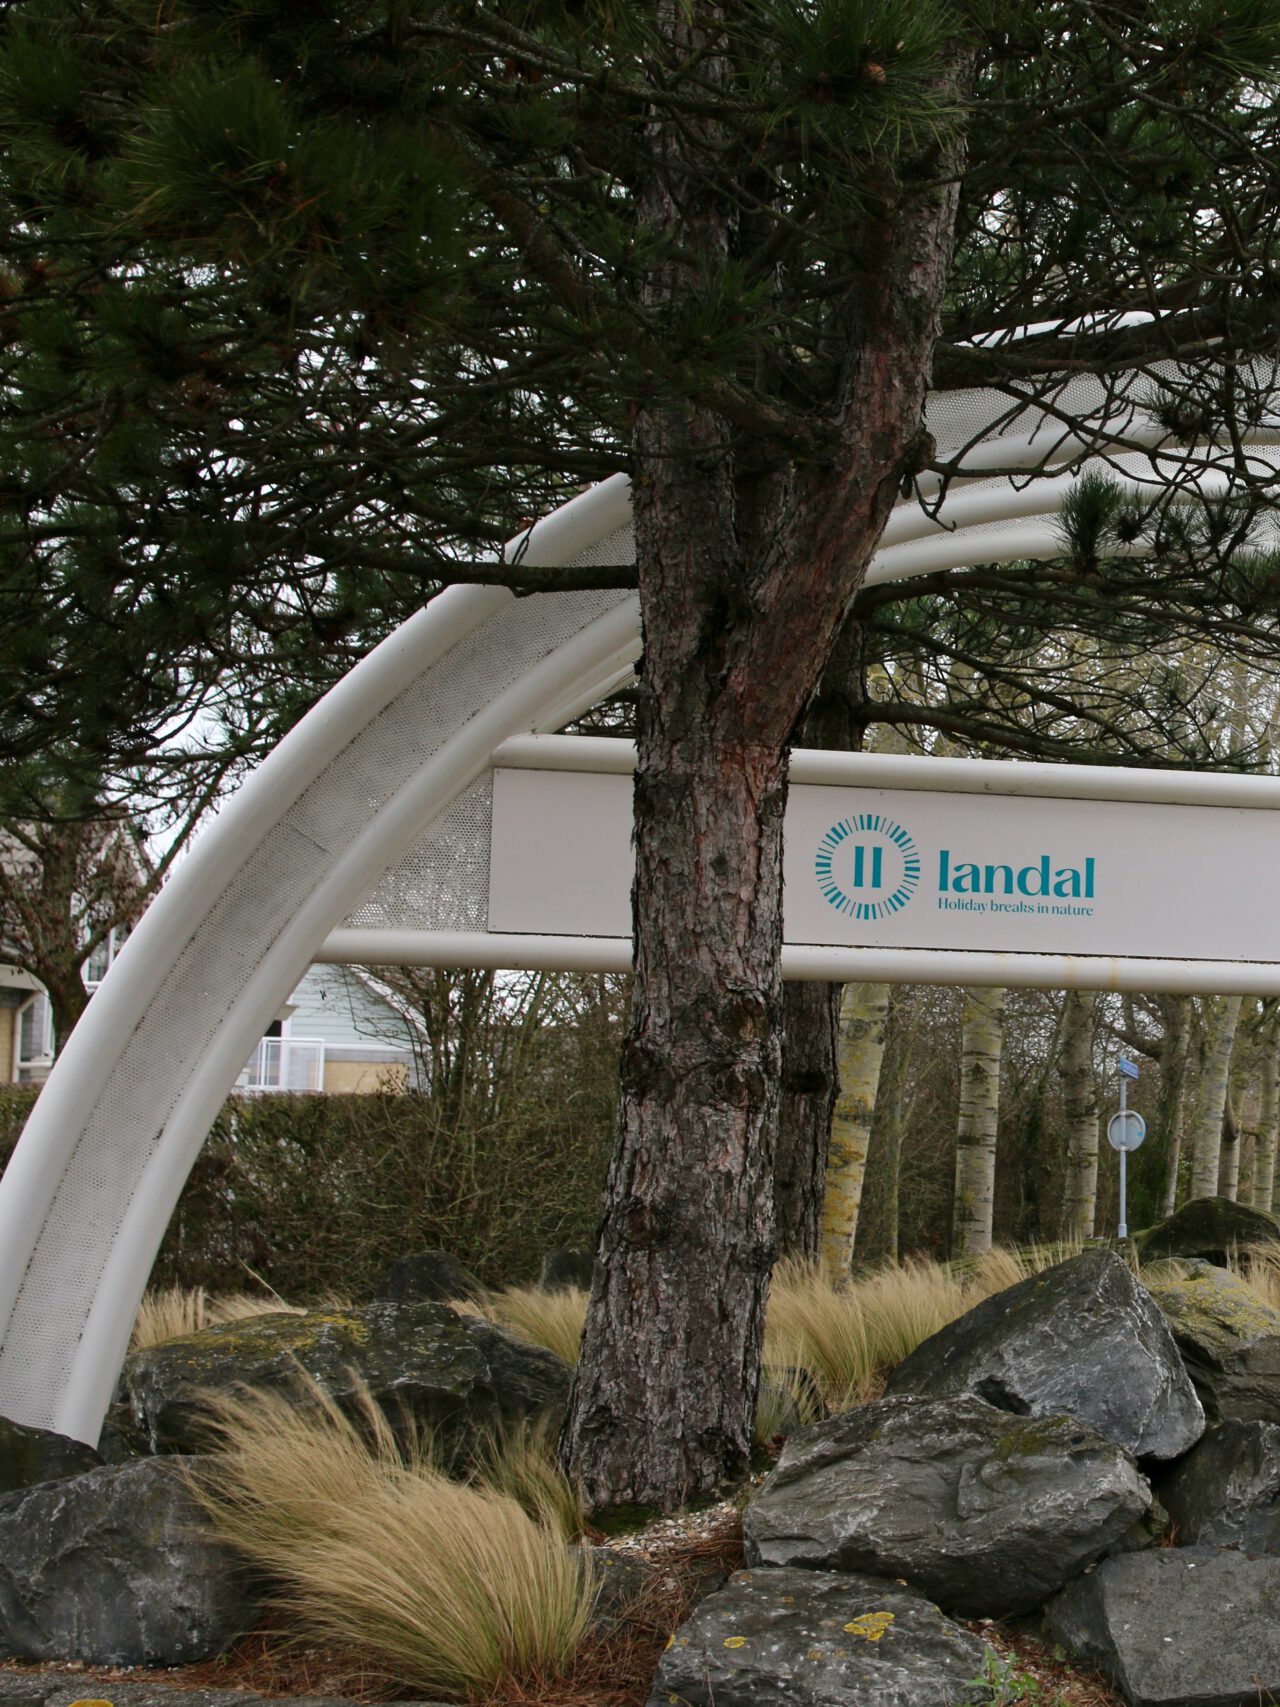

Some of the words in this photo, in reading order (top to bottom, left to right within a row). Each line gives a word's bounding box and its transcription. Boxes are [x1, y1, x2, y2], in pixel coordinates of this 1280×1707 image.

[938, 849, 1095, 898] landal
[937, 897, 988, 915] Holiday
[990, 900, 1035, 914] breaks
[1037, 902, 1050, 914] in
[1051, 904, 1094, 917] nature
